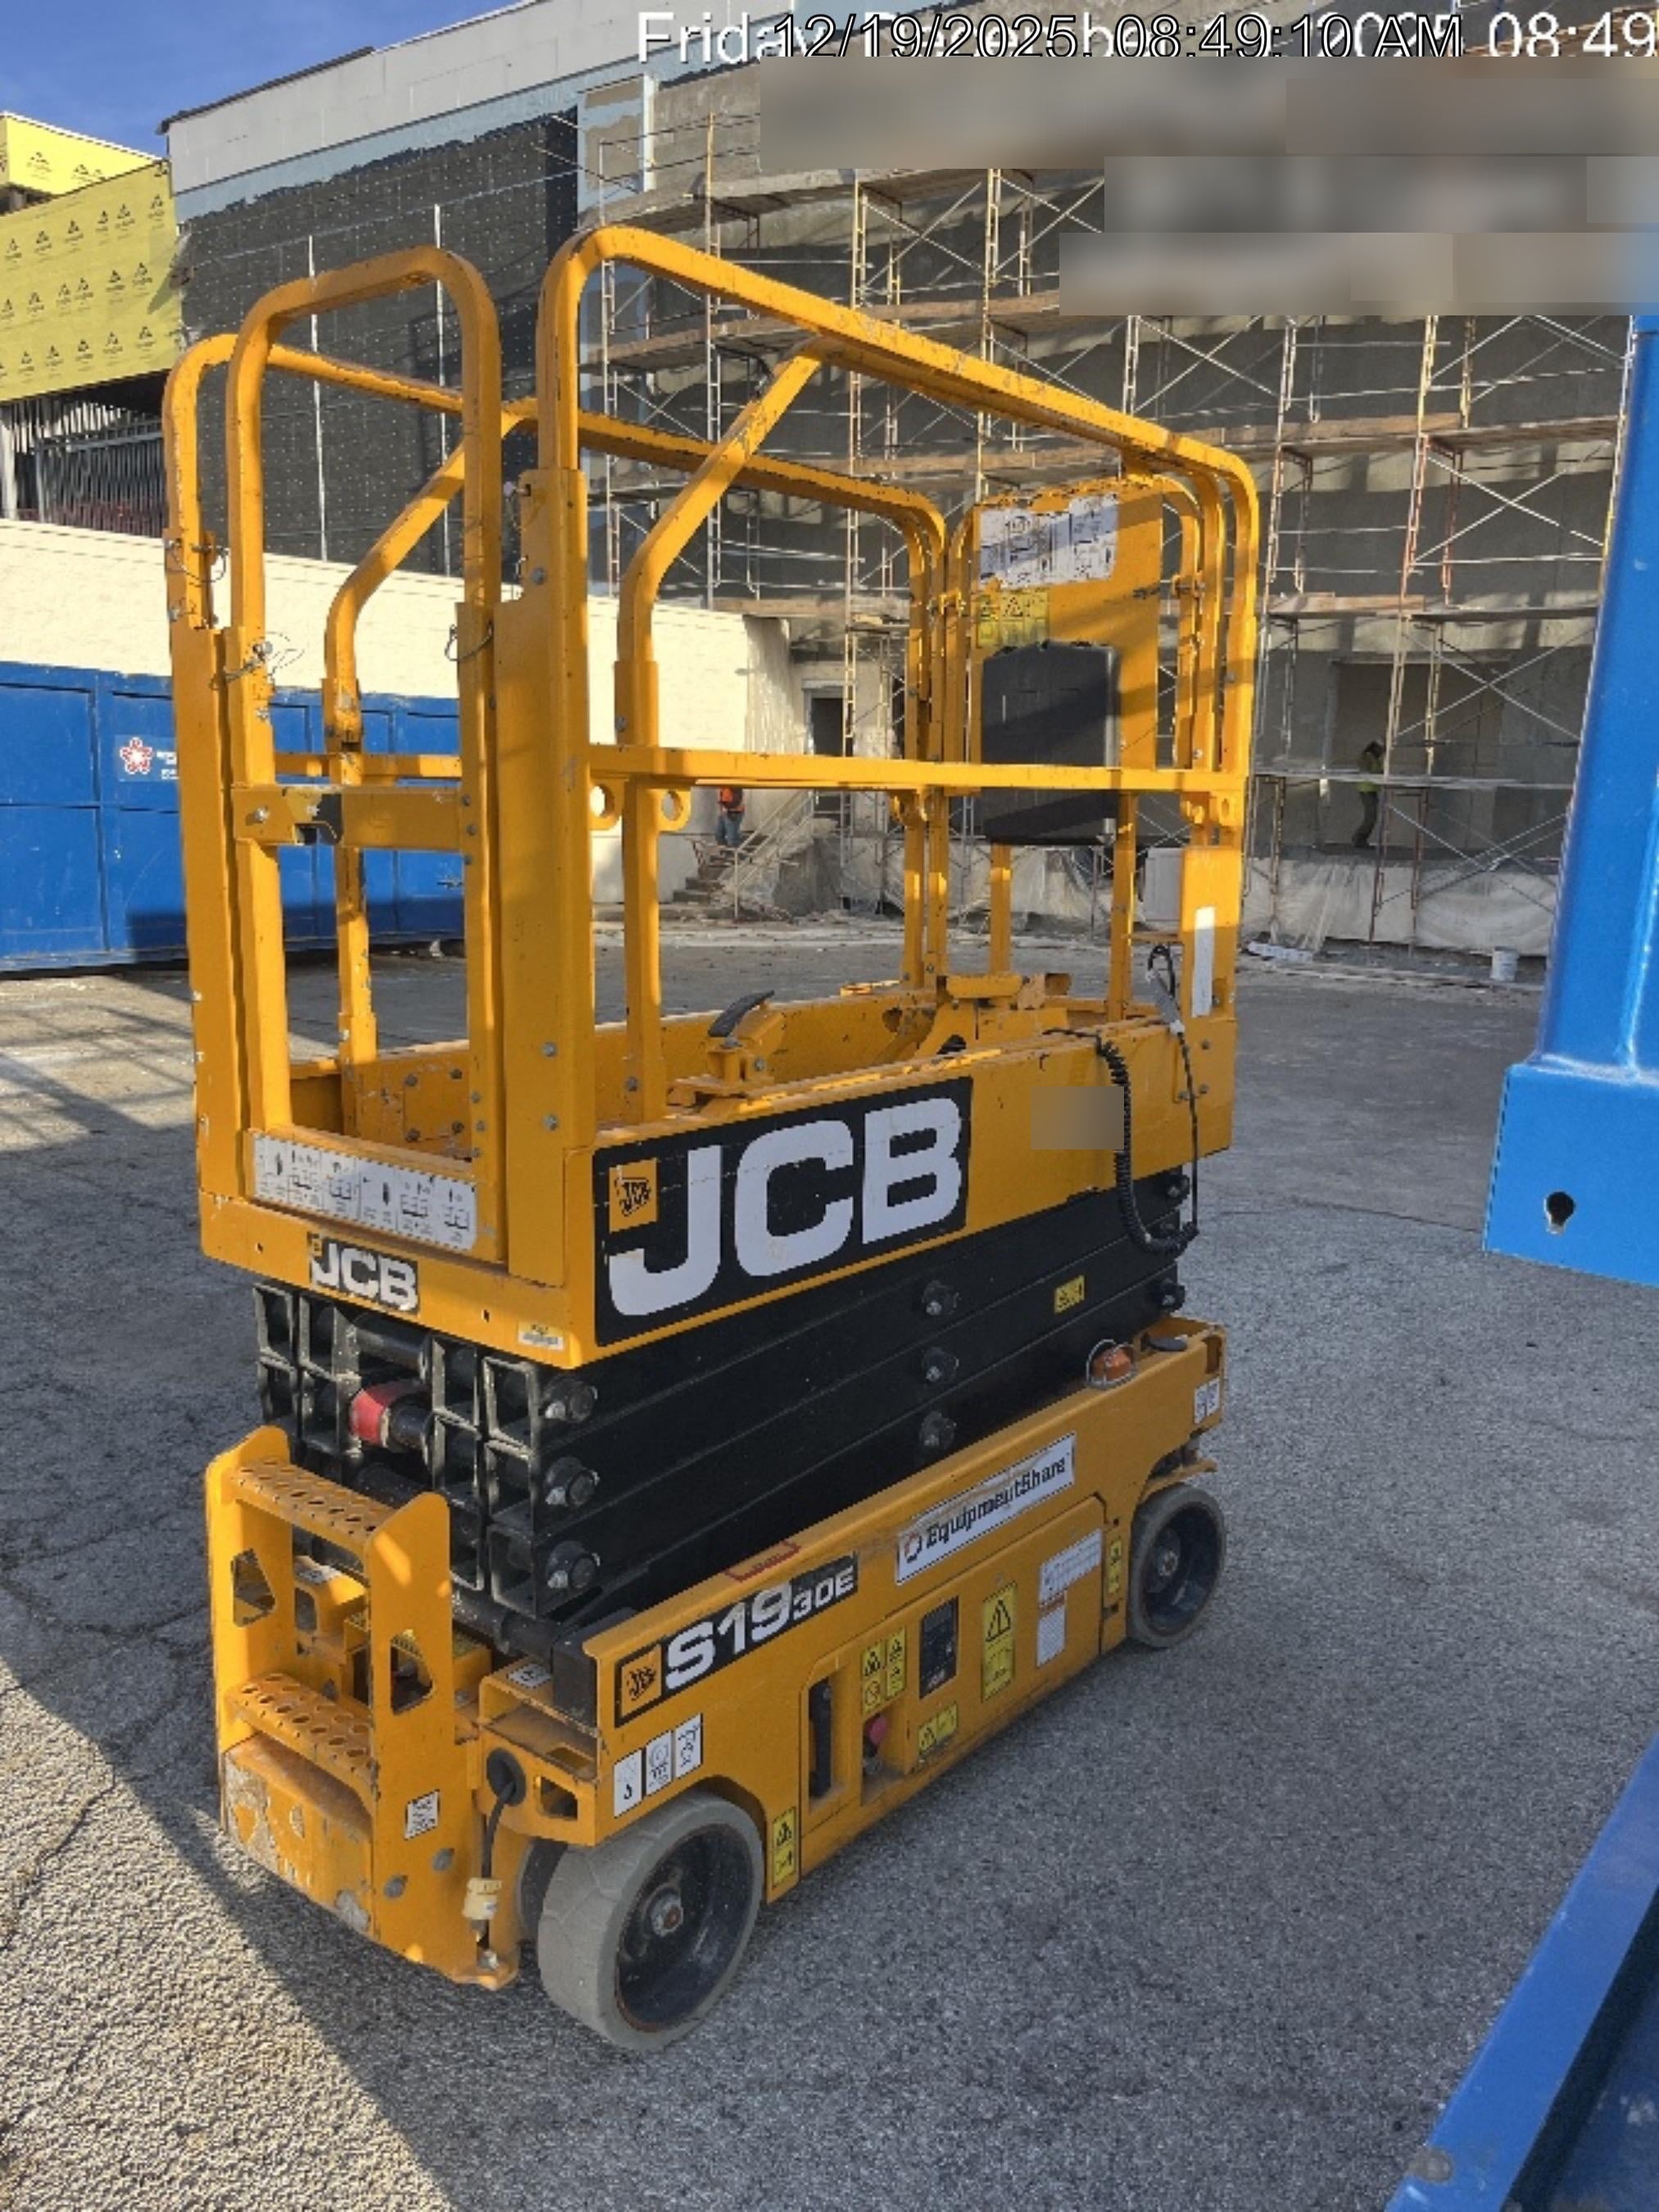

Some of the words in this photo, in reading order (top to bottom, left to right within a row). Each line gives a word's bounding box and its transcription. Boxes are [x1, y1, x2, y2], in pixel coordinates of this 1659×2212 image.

[609, 1098, 962, 1316] JCB
[312, 1243, 418, 1310] JCB
[927, 1457, 1066, 1549] EquipmentShare
